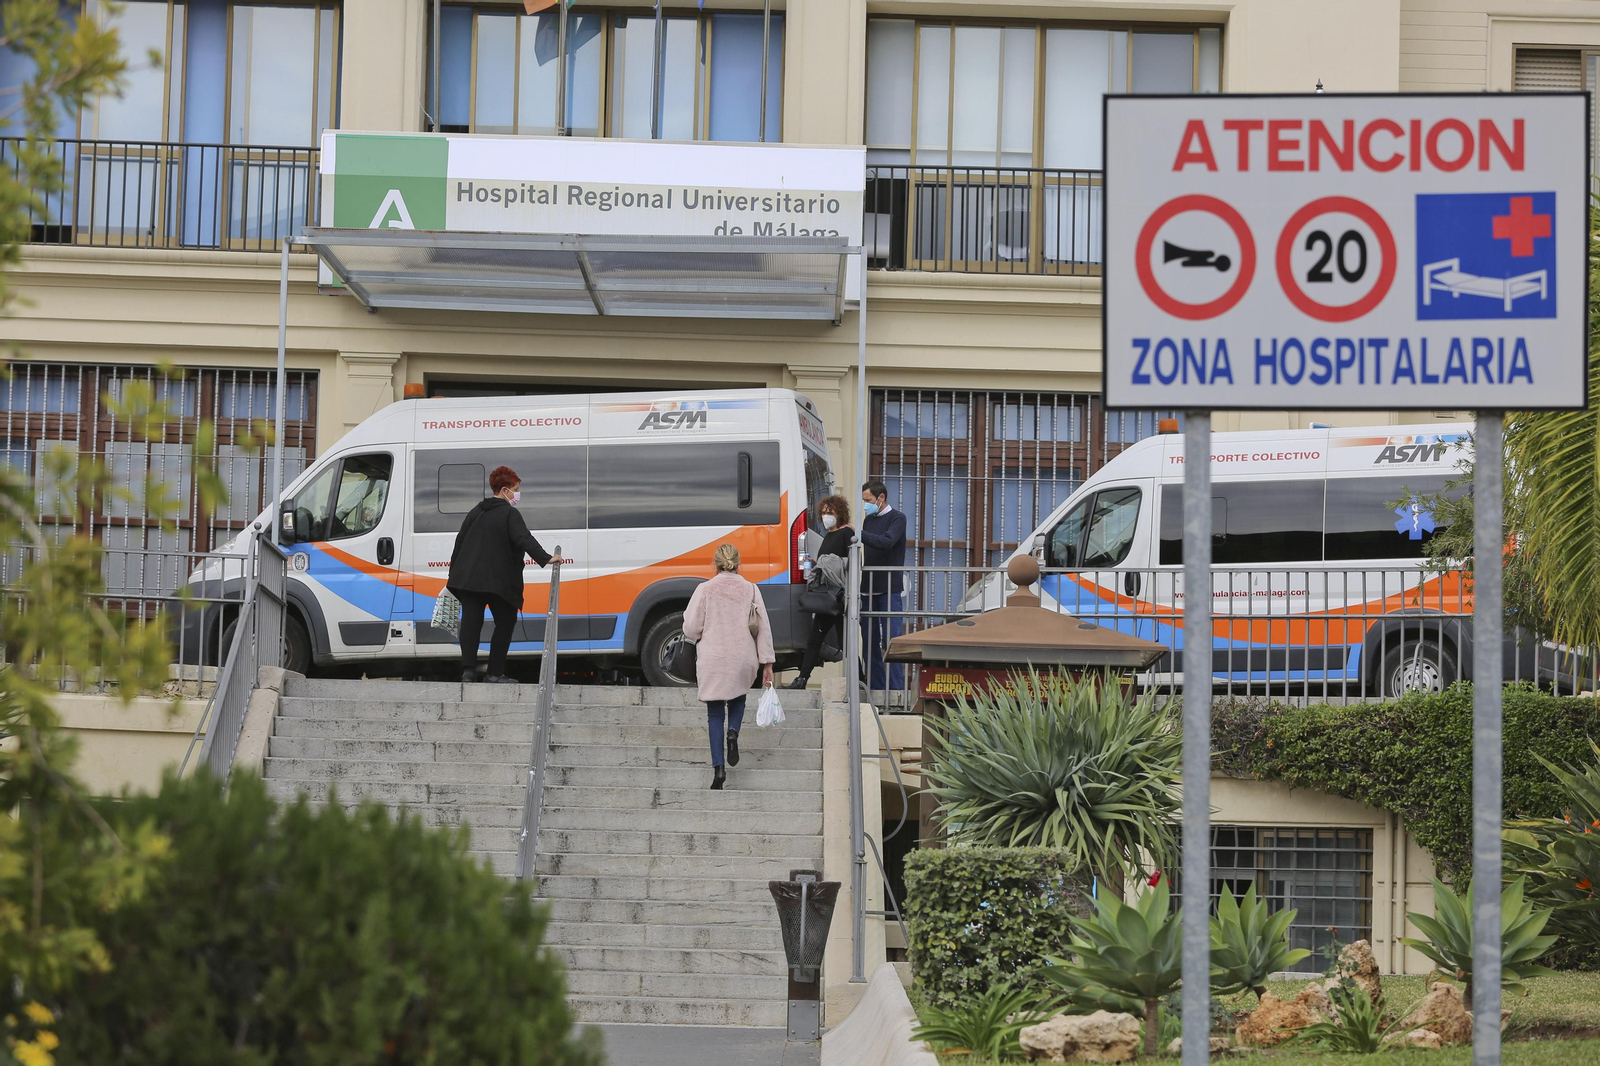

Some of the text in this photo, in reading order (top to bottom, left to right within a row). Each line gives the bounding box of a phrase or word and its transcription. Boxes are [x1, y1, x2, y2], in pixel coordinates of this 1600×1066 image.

[1172, 118, 1525, 172] ATENCION
[457, 182, 841, 214] Hospital Regional Universitario
[714, 220, 743, 236] de
[1305, 229, 1368, 283] 20
[1131, 337, 1534, 385] ZONA HOSPITALARIA
[422, 417, 582, 430] TRANSPORTE COLECTIVO
[637, 411, 707, 430] ASM
[1169, 451, 1320, 465] TRPORTE COLECTIVO
[1373, 444, 1441, 464] ASM
